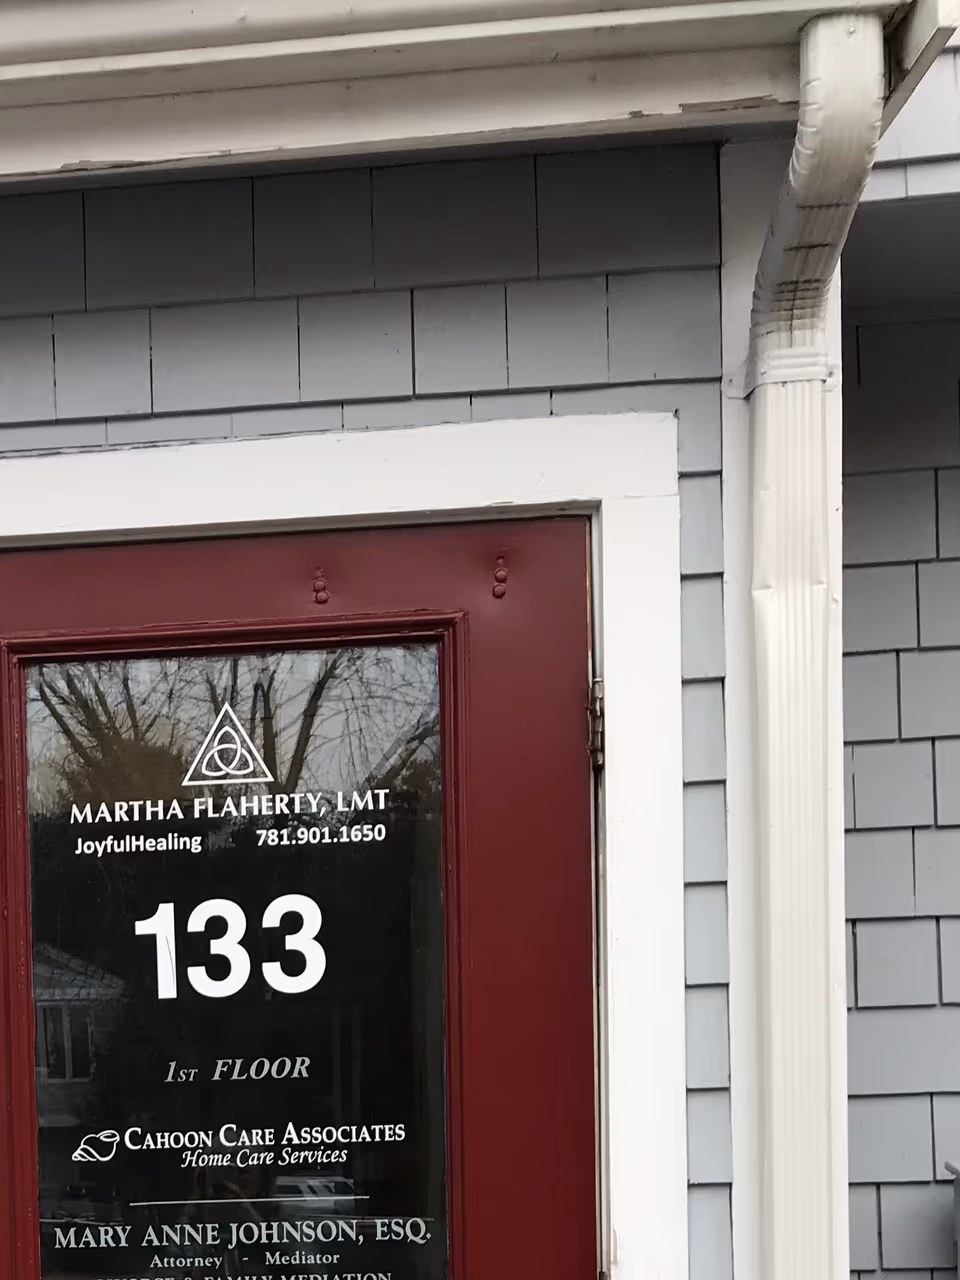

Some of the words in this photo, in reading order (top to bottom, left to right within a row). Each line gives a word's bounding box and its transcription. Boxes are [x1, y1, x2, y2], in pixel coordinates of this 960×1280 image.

[70, 799, 184, 824] MARTHA
[194, 793, 327, 818] FLAHERTY,
[337, 789, 390, 812] LMT
[75, 832, 202, 857] JoyfulHealing
[256, 824, 386, 847] 781.901.1650
[134, 894, 327, 999] 133
[212, 1056, 311, 1081] FLOOR
[181, 1150, 231, 1168] Home
[236, 1149, 274, 1167] Care
[278, 1147, 348, 1165] Services
[55, 1225, 131, 1249] MARY
[142, 1224, 220, 1247] ANNE
[228, 1219, 365, 1249] JOHNSON,
[376, 1218, 432, 1242] ESQ.
[150, 1254, 223, 1269] Attorney
[265, 1251, 340, 1266] Mediator
